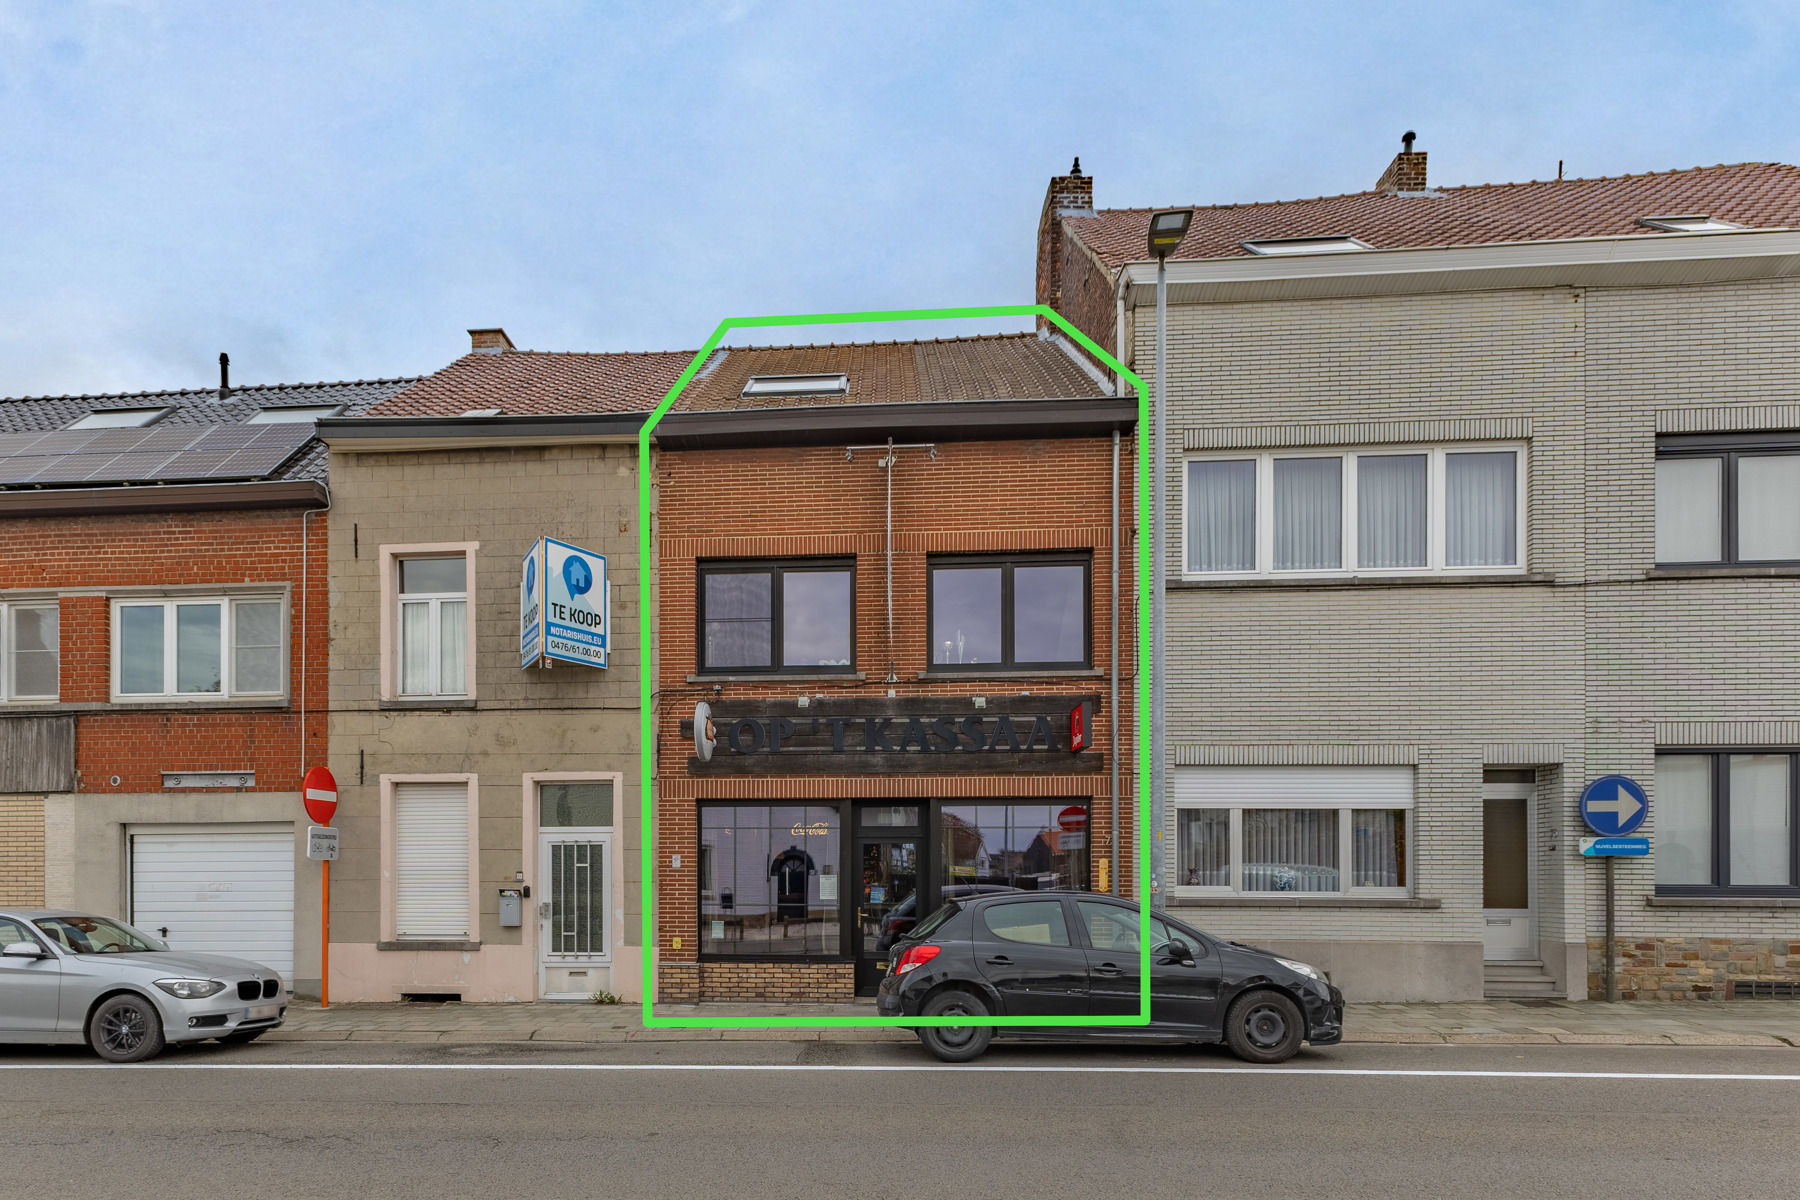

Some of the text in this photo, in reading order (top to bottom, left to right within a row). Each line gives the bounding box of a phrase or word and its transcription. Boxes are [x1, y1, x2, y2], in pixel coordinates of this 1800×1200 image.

[551, 602, 602, 628] TE KOOP
[550, 626, 602, 645] NOTARISHUIS.EU
[550, 640, 602, 658] 0476/61.00.00
[728, 717, 796, 754] OP
[811, 716, 852, 752] 'T
[864, 715, 1059, 752] KASSAA
